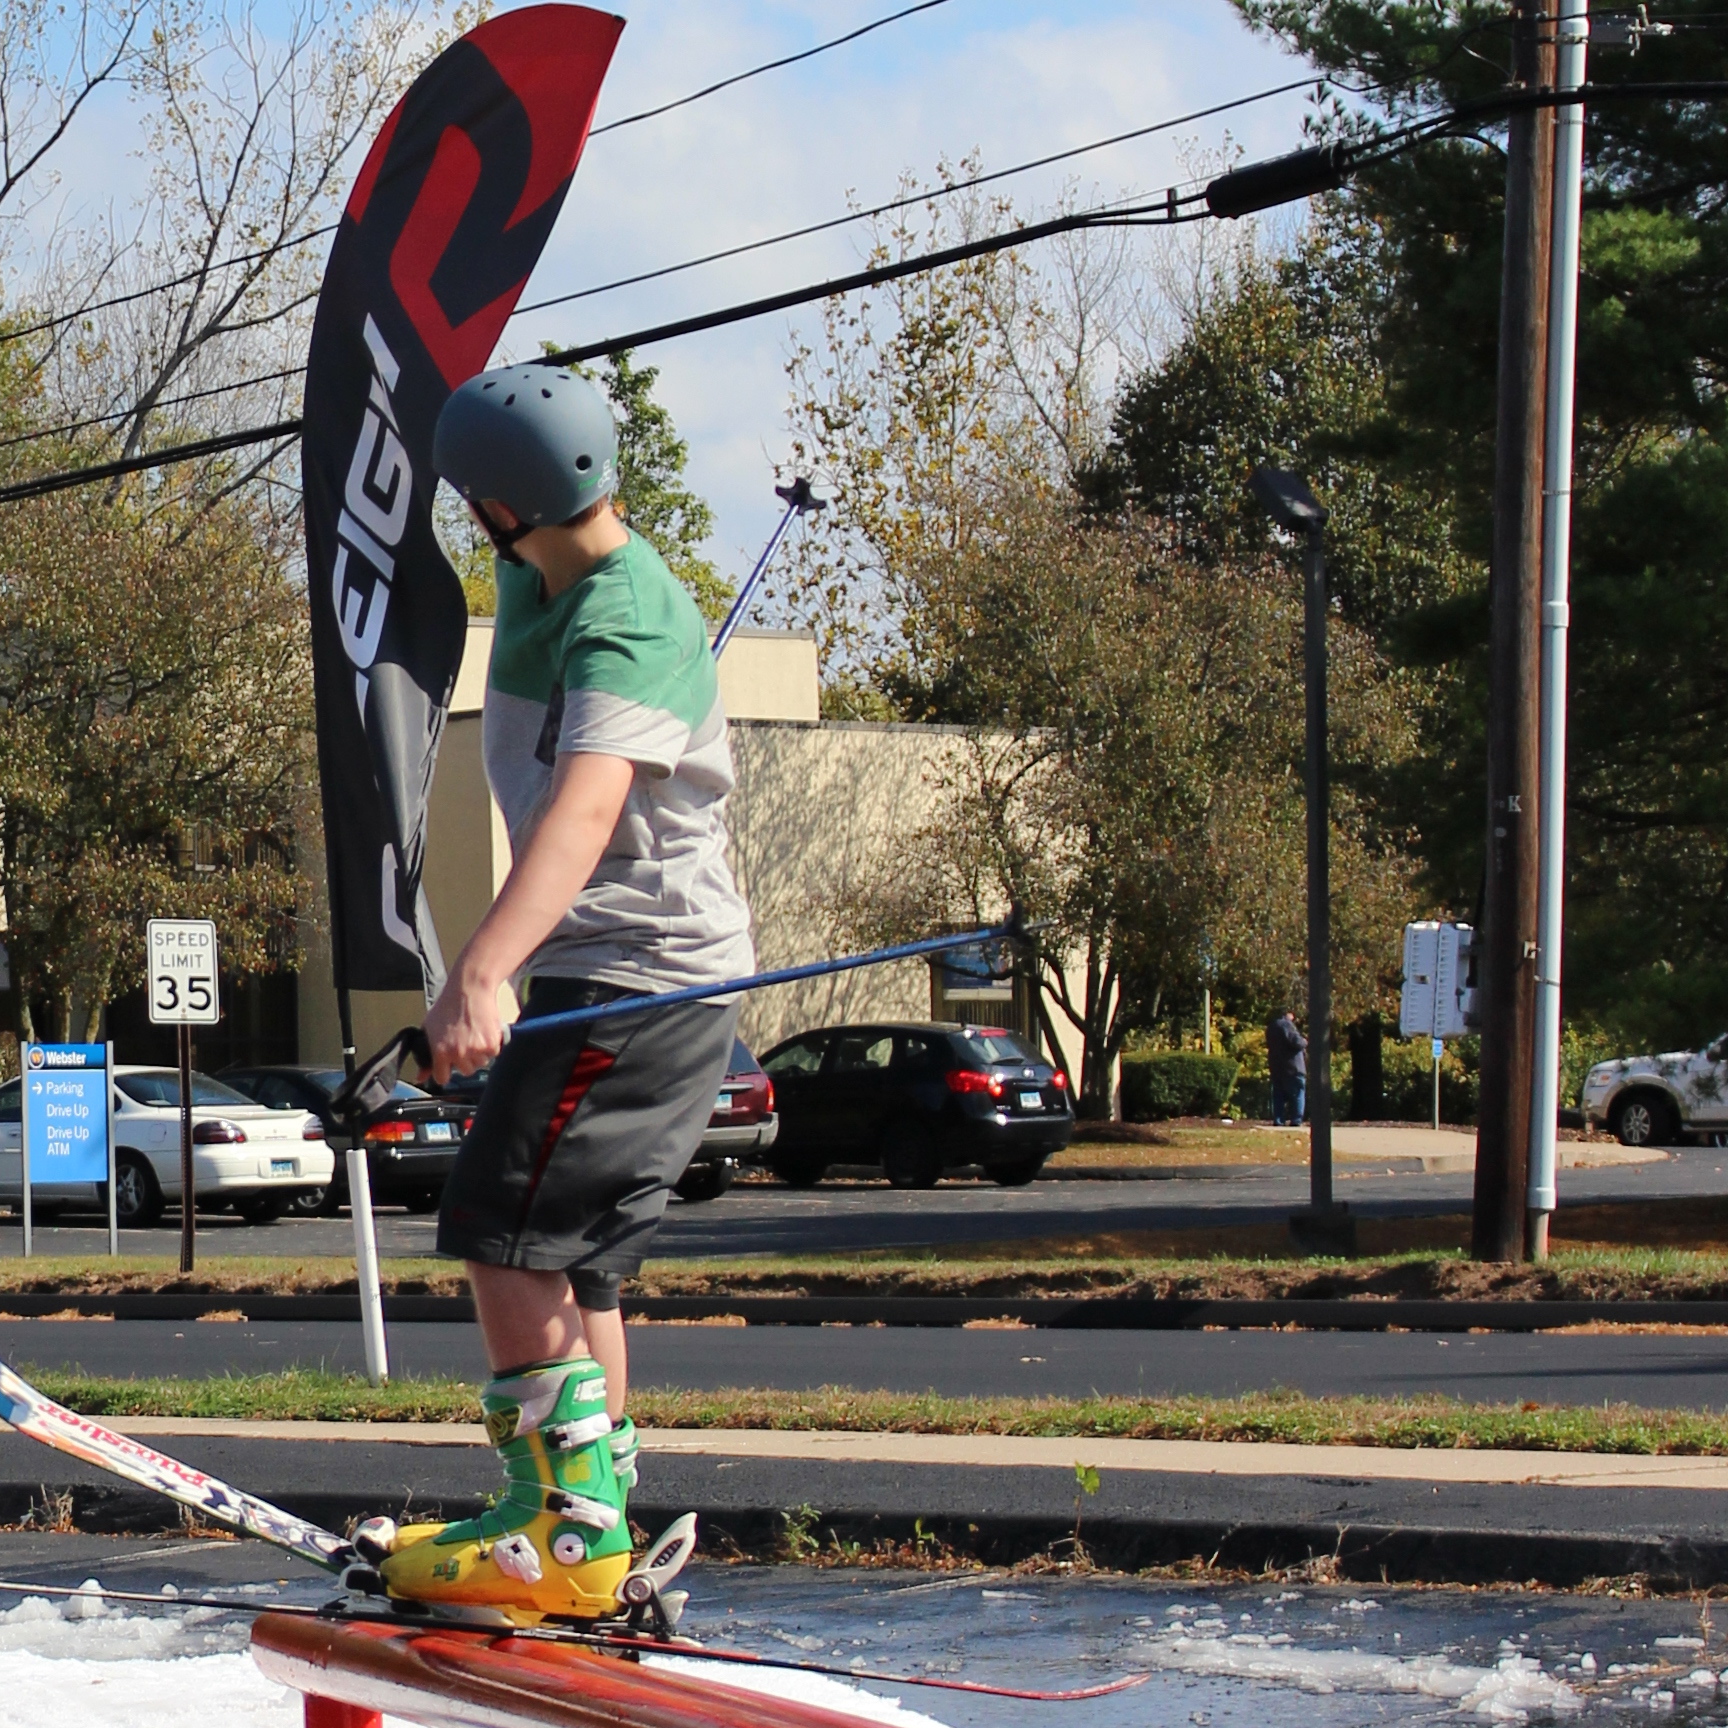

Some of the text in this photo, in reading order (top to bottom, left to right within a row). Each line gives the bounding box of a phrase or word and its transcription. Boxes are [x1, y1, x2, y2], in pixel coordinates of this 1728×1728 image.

[154, 931, 210, 947] SPEED
[161, 954, 204, 969] LIMIT
[156, 975, 212, 1011] 35
[46, 1051, 87, 1065] Webster
[46, 1081, 84, 1097] Parking
[46, 1103, 89, 1118] Drive Up
[47, 1125, 90, 1140] Drive Up
[47, 1142, 71, 1156] ATM
